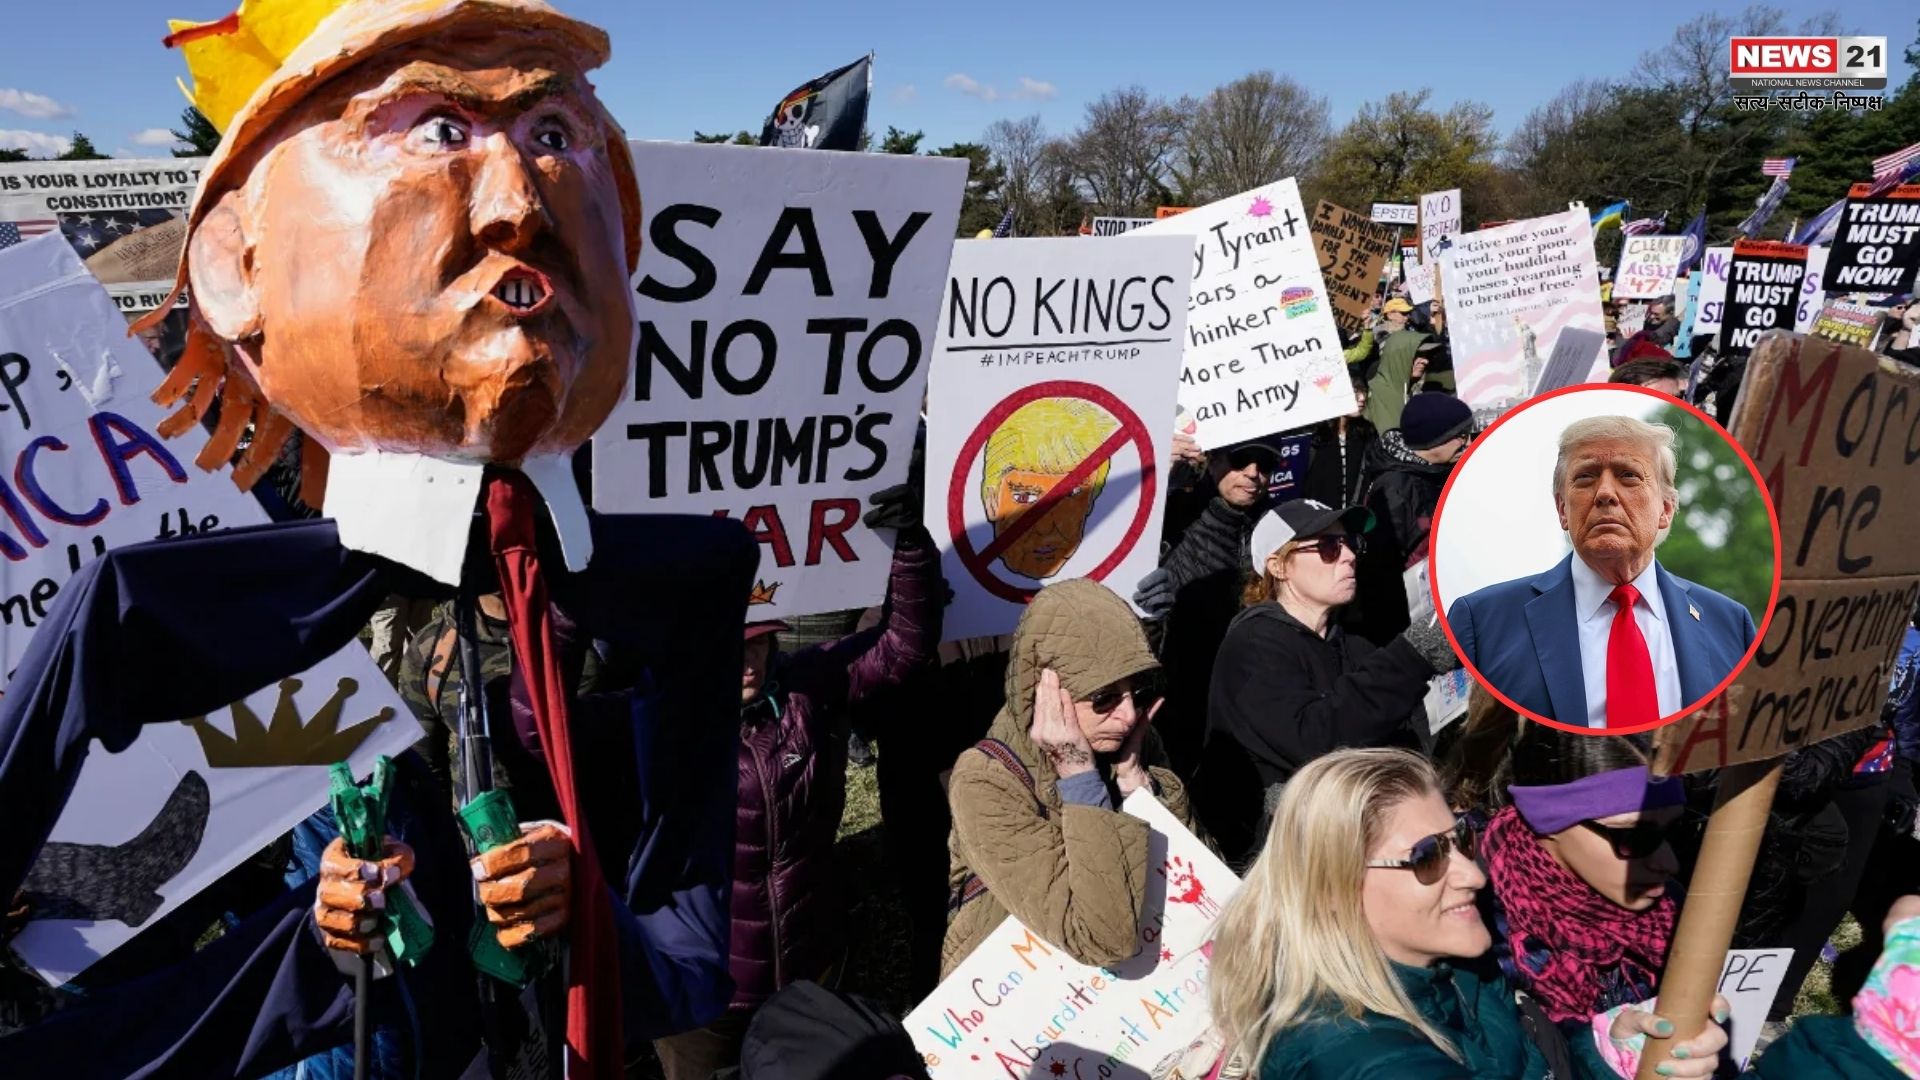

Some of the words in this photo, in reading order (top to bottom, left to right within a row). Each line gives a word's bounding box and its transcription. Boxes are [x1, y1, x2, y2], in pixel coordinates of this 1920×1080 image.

[2, 176, 18, 190] IS
[24, 174, 78, 190] YOUR
[83, 171, 161, 189] LOYALTY
[164, 169, 188, 185] TO
[46, 191, 187, 211] CONSTITUTION?
[1319, 203, 1335, 220] I
[1425, 195, 1450, 216] NO
[1372, 207, 1416, 221] EPSTE
[1849, 203, 1920, 223] TRUM
[1093, 219, 1127, 236] STOP
[1209, 208, 1300, 270] Tyrant
[1506, 233, 1527, 244] me
[1532, 226, 1568, 241] your
[1846, 224, 1920, 244] MUST
[636, 203, 933, 302] SAY
[1321, 239, 1341, 254] FOR
[1349, 249, 1371, 267] THE
[1454, 253, 1494, 269] tired,
[1498, 246, 1534, 262] your
[1537, 238, 1577, 254] poor,
[1856, 246, 1894, 265] GO
[1467, 266, 1501, 281] your
[1505, 250, 1567, 272] huddled
[1625, 262, 1676, 279] AISLE
[1734, 260, 1803, 285] TRUMP
[1836, 266, 1905, 287] NOW!
[1253, 274, 1282, 289] a
[1324, 276, 1370, 304] NDMENT
[1457, 280, 1509, 295] masses
[1512, 263, 1582, 286] yearning
[112, 295, 136, 308] TO
[140, 293, 188, 307] RUS
[949, 276, 1016, 338] NO
[1033, 275, 1175, 336] KINGS
[1458, 298, 1473, 308] to
[1477, 286, 1536, 305] breathe
[1735, 284, 1794, 306] MUST
[1189, 304, 1279, 348] hinker
[1745, 306, 1777, 327] GO
[635, 318, 778, 401] NO
[806, 317, 922, 396] TO
[980, 348, 1141, 367] #IMPEACHTRUMP
[1251, 335, 1323, 364] Than
[1196, 402, 1227, 422] an
[1236, 379, 1300, 412] Army
[627, 403, 893, 499] TRUMP'S
[712, 497, 861, 568] AR
[1755, 580, 1919, 675] overning
[927, 1008, 984, 1050] Who
[971, 969, 1024, 1007] Can
[995, 967, 1118, 1080] Absurdities
